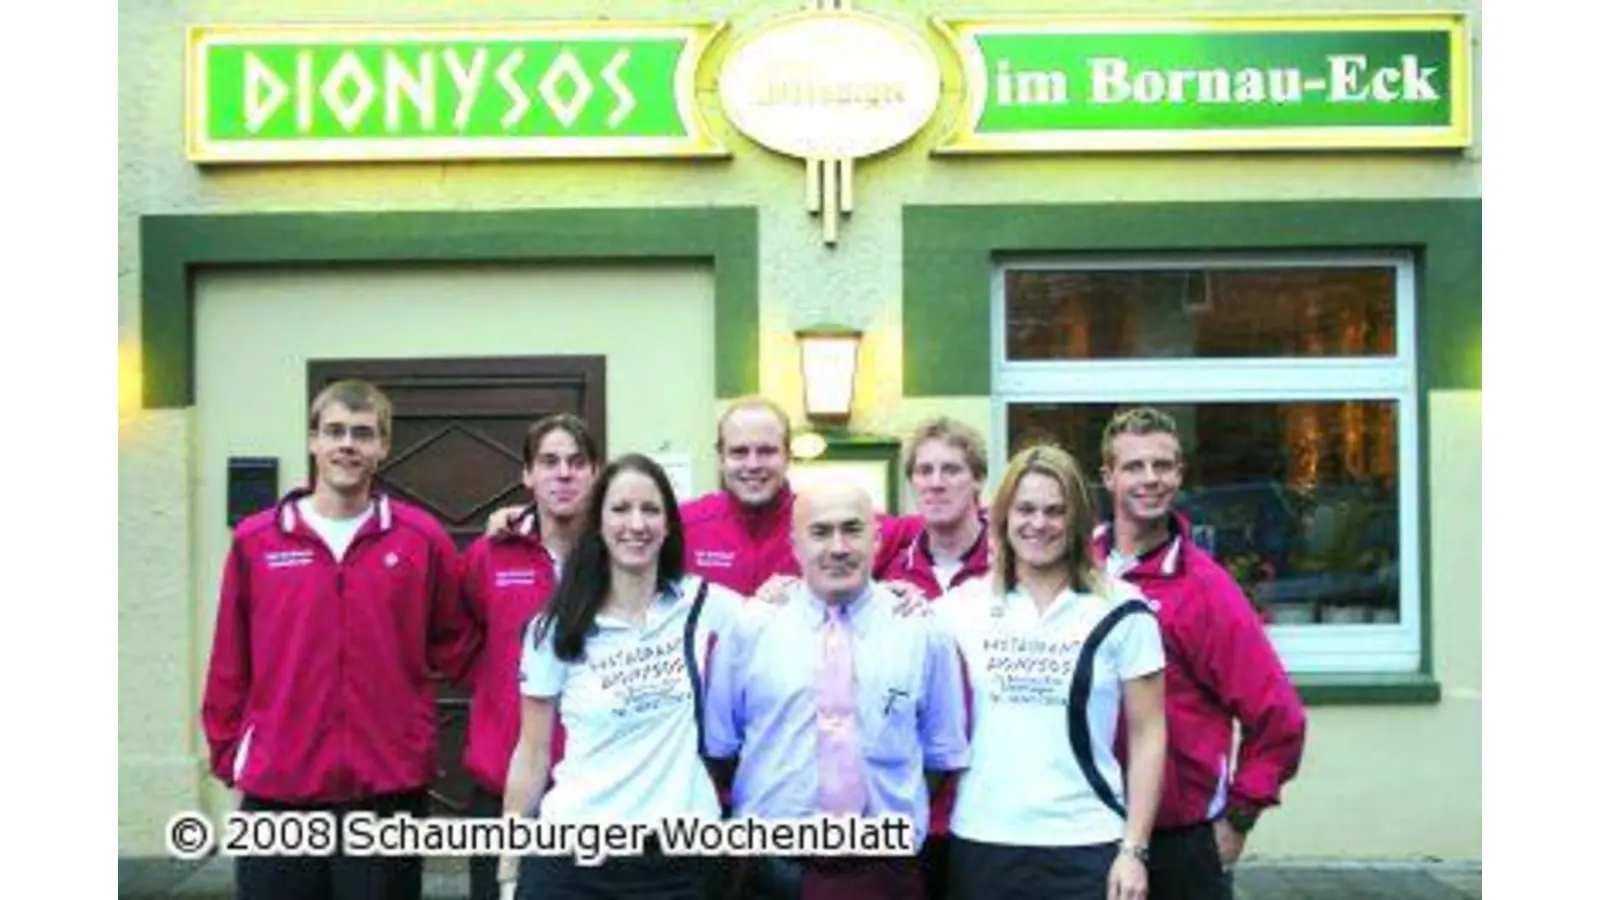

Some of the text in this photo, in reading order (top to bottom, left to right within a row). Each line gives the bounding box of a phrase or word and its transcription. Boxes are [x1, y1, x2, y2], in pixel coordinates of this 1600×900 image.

[243, 45, 637, 133] DIONYSOS
[996, 53, 1440, 105] im Bornau-Eck
